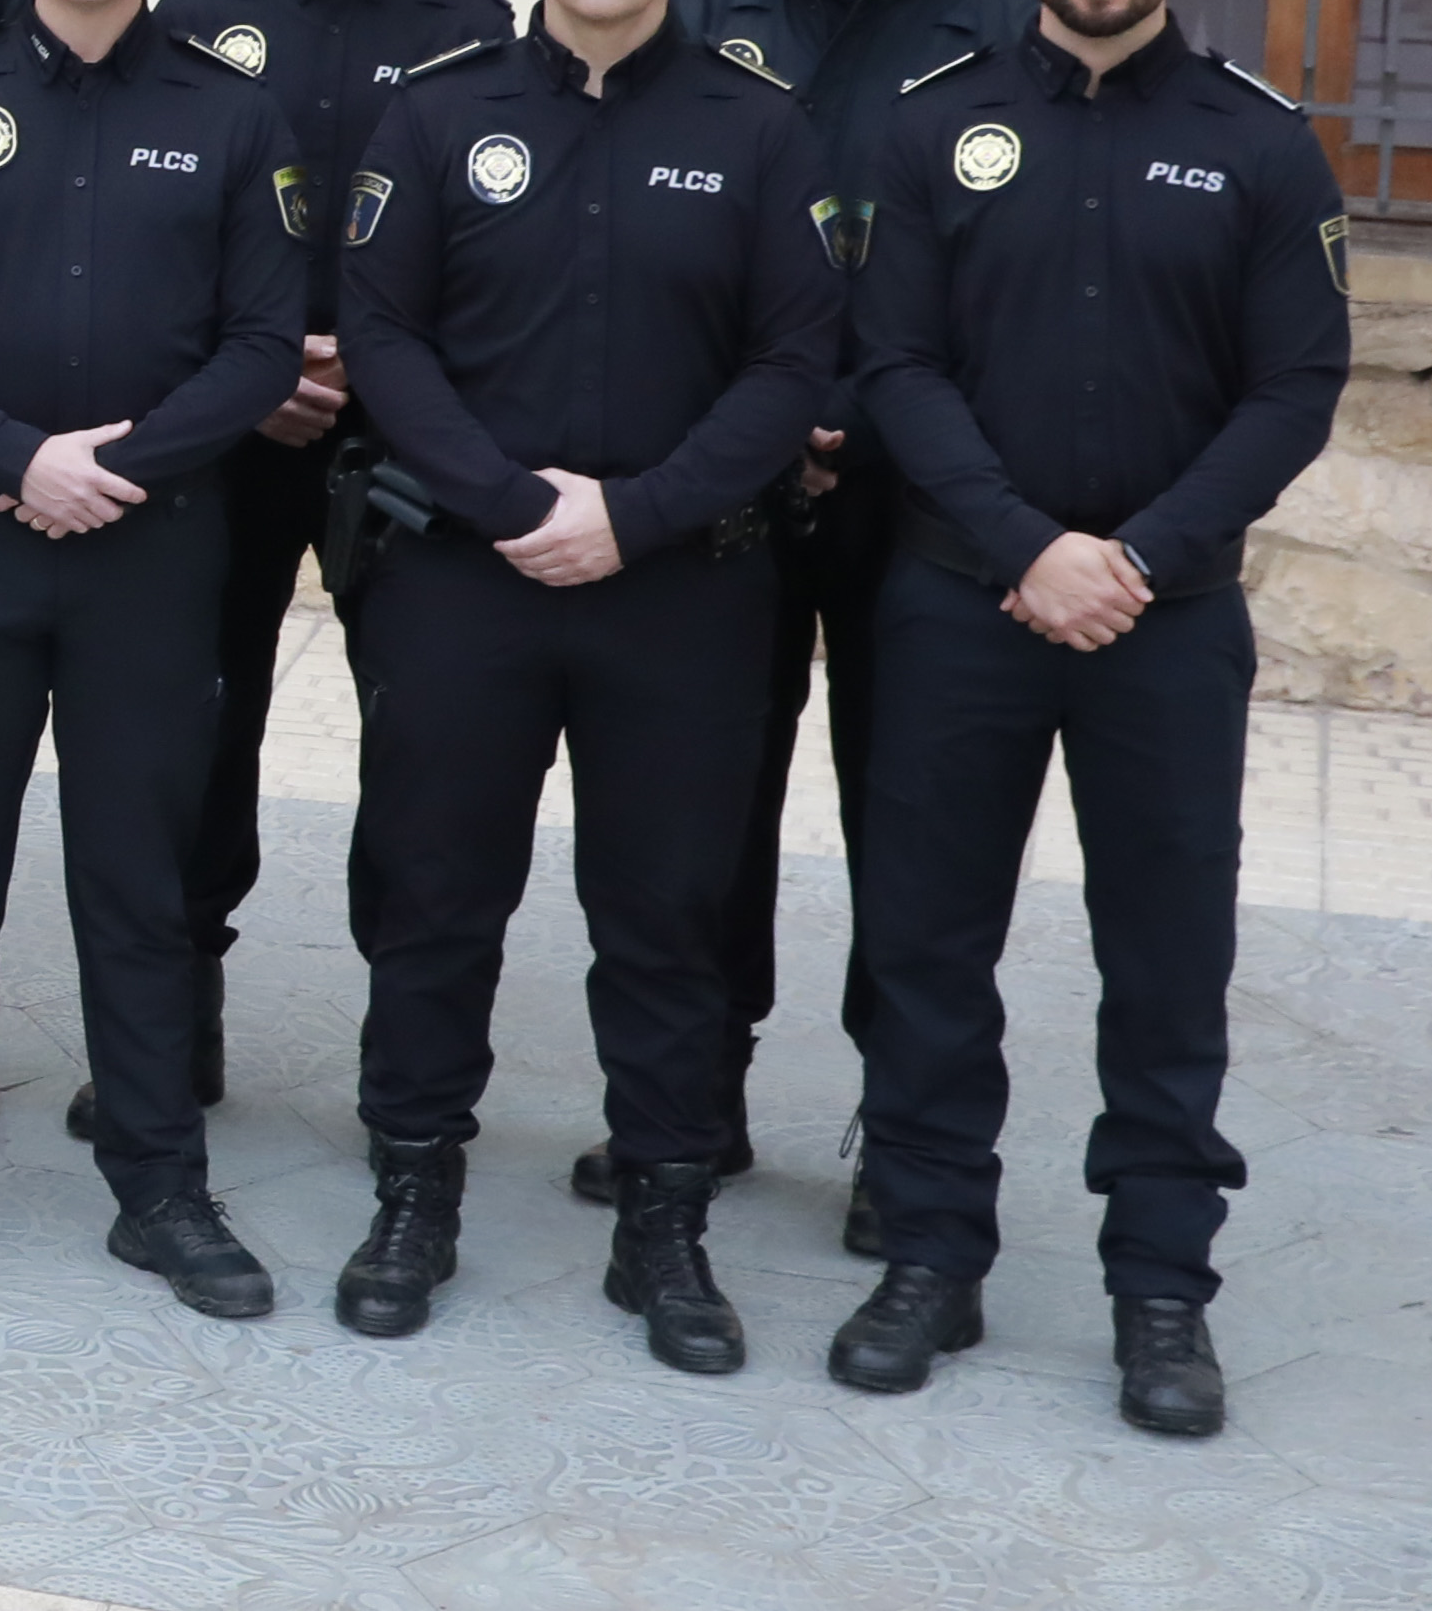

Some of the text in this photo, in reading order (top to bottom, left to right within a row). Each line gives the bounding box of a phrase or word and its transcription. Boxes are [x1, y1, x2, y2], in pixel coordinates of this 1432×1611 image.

[130, 148, 199, 173] PLCS
[648, 166, 724, 193] PLCS
[1146, 161, 1225, 192] PLCS
